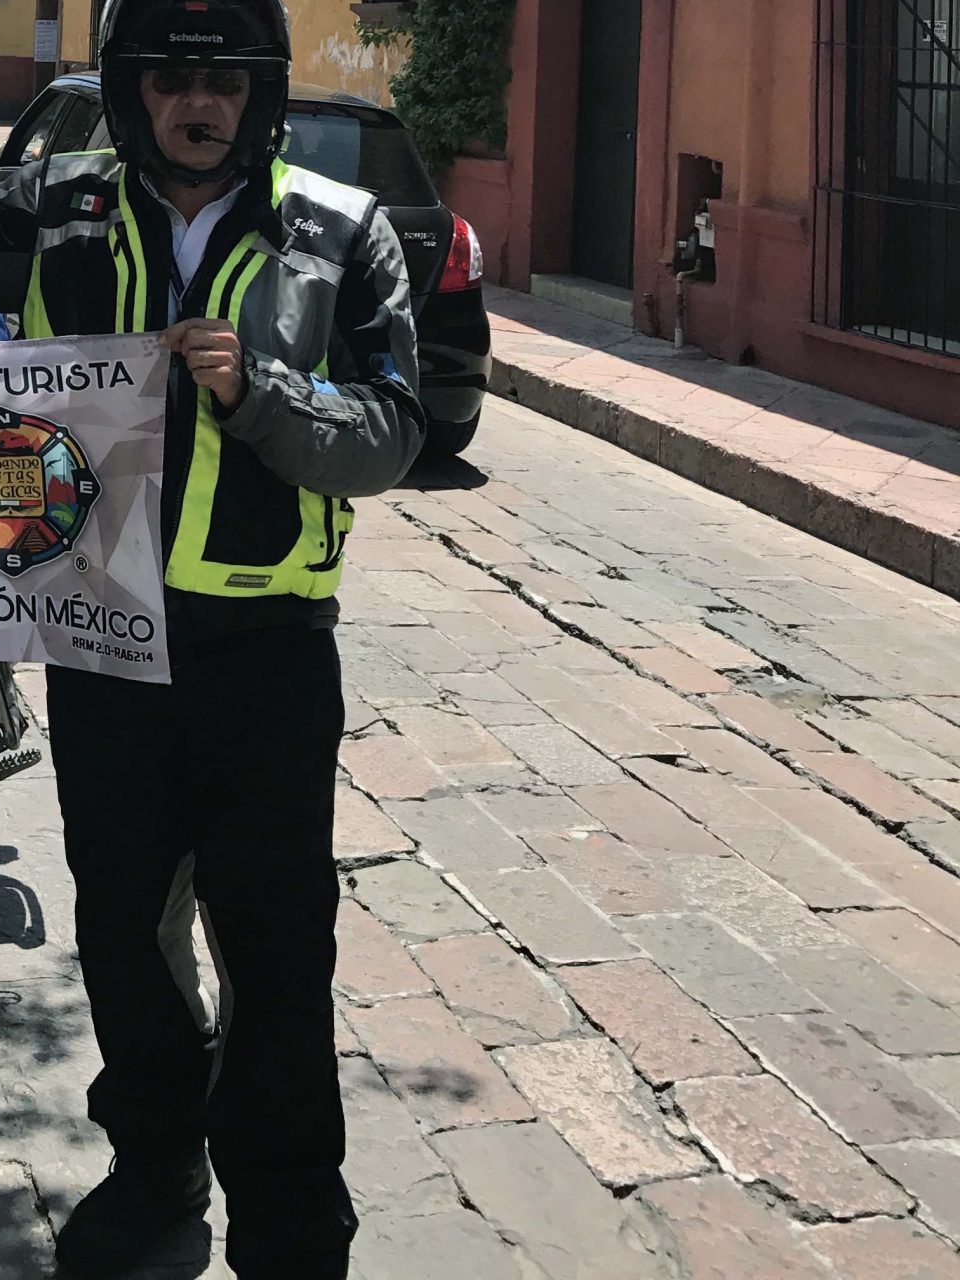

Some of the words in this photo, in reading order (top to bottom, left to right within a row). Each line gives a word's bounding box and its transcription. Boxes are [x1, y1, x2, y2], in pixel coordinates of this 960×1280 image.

[169, 32, 223, 44] Schuberth
[292, 218, 324, 237] Felipe
[79, 480, 93, 494] E
[6, 554, 22, 567] S
[45, 592, 155, 643] MÉXICO
[72, 636, 94, 652] RRM
[95, 641, 154, 663] 2.0-RA6214
